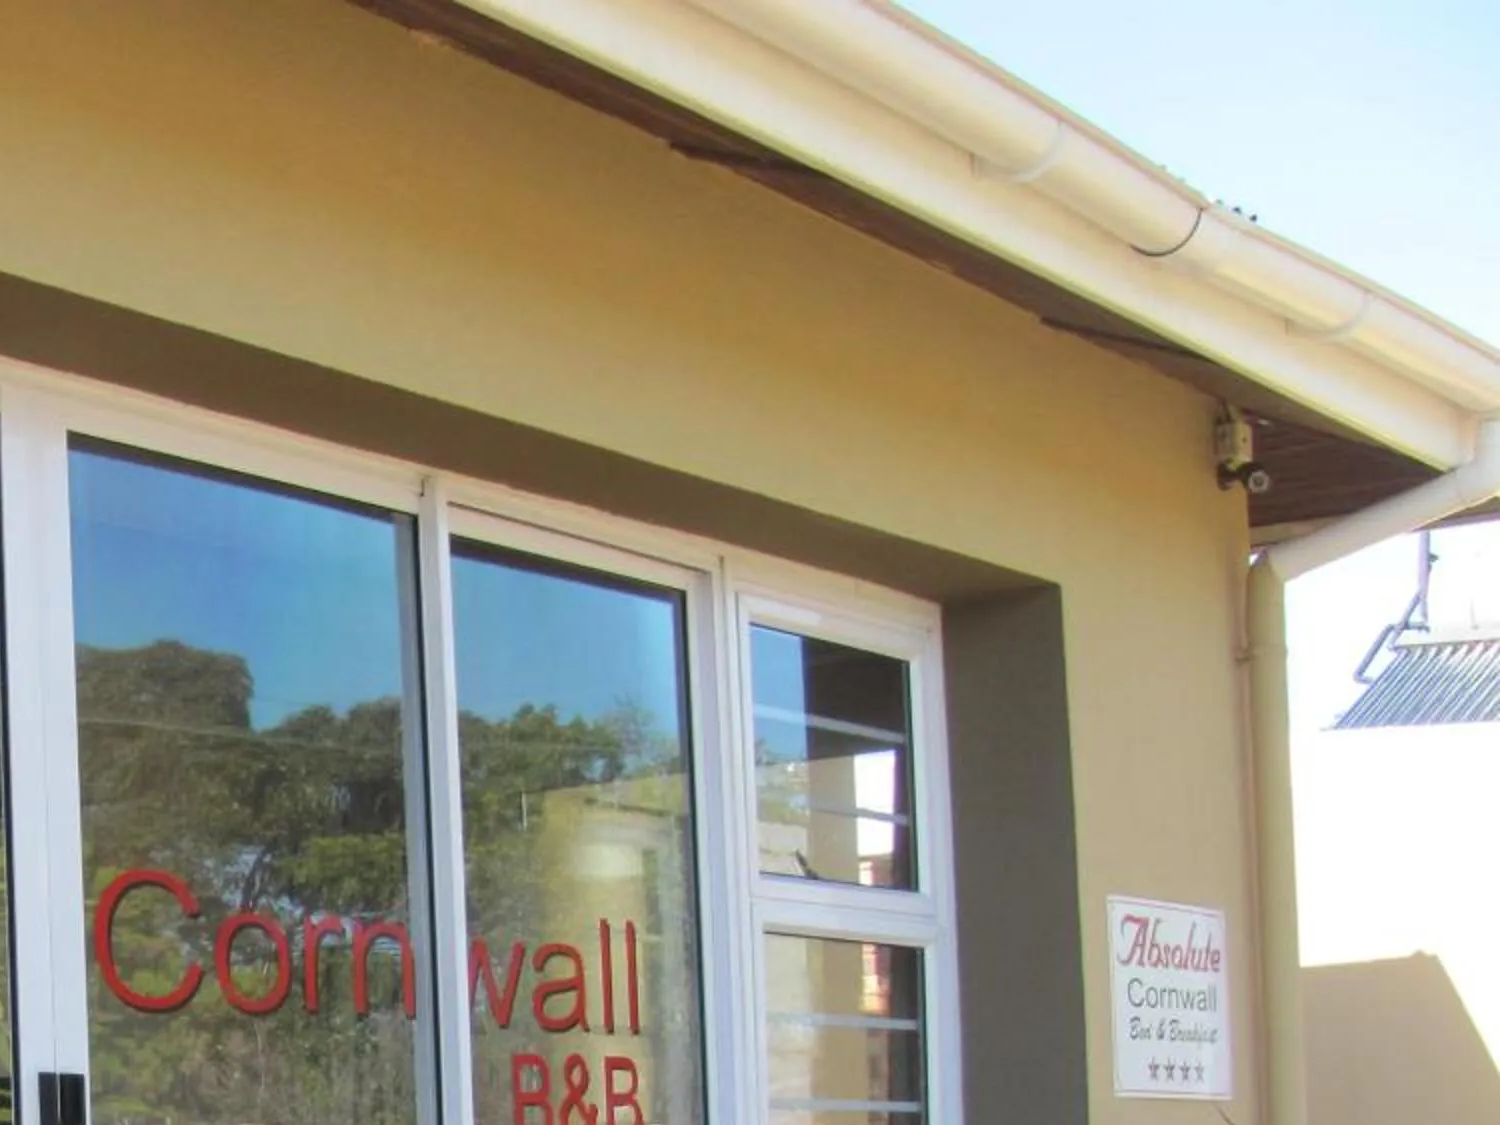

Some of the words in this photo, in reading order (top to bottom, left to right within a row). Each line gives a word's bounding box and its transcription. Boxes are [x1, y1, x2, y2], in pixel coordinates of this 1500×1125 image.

[92, 868, 641, 1036] Cornwall
[1117, 914, 1220, 972] Absolute
[1127, 977, 1218, 1013] Cornwall
